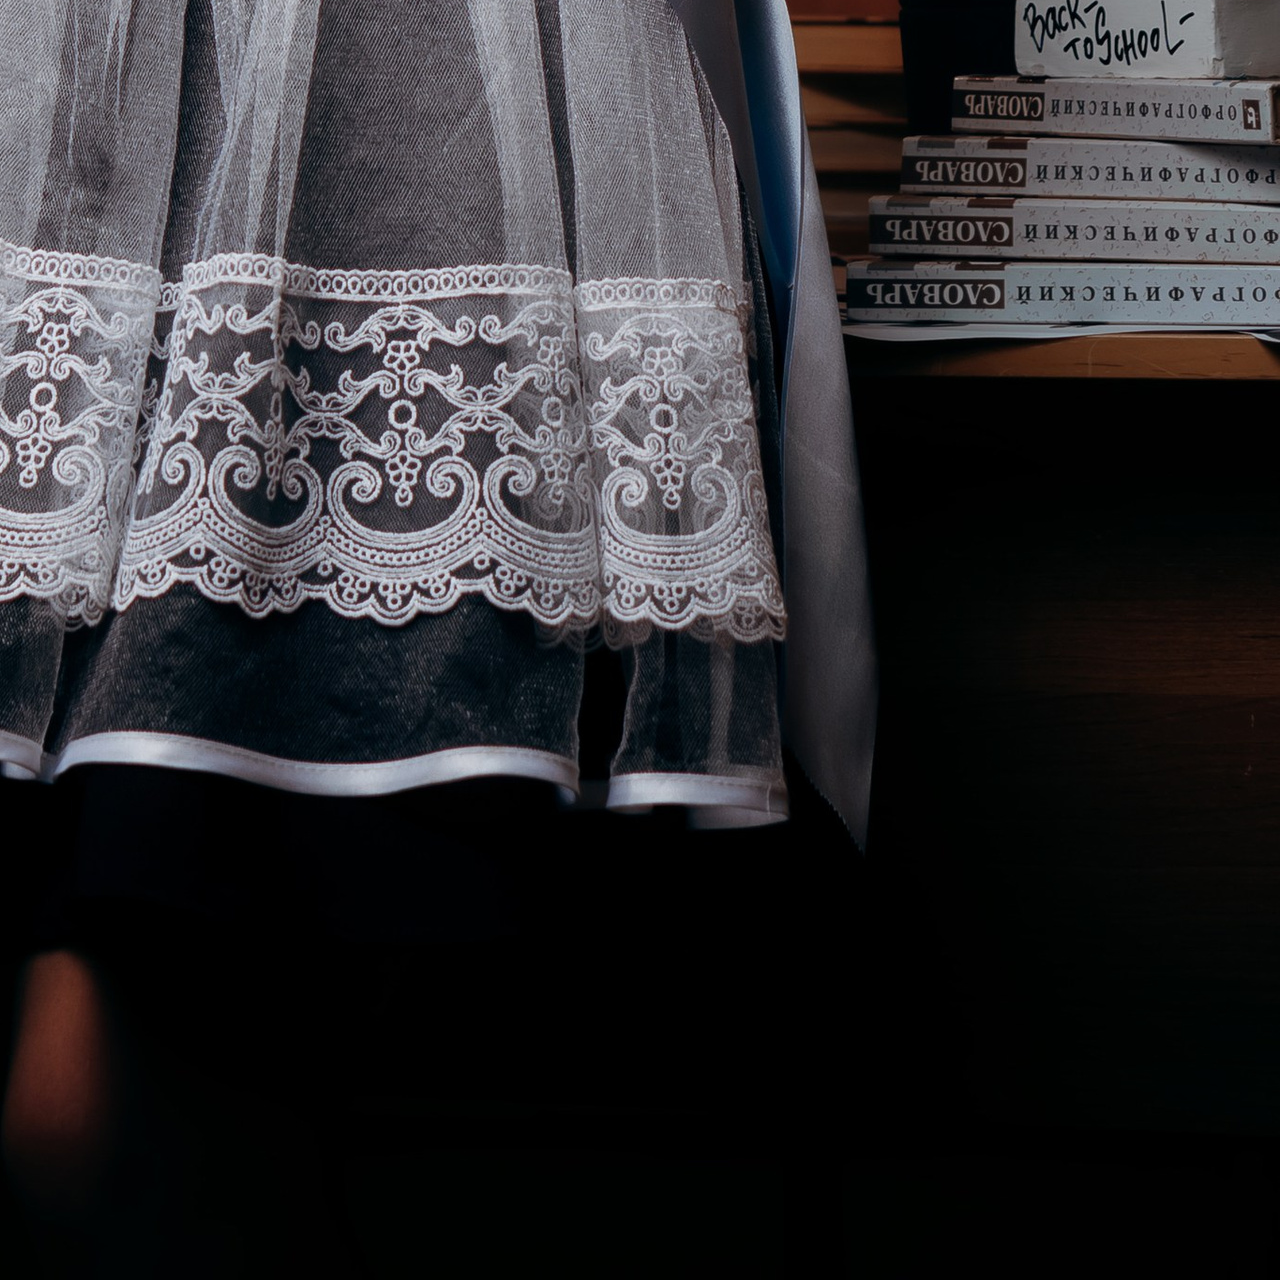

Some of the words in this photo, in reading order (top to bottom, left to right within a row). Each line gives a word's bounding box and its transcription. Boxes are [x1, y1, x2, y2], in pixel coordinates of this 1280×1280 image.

[964, 93, 1044, 120] СЛОВАРЬ
[1050, 97, 1238, 122] ОРФОГРАФИЧЕСКИЙ
[914, 160, 1025, 185] СЛОВАРЬ
[884, 216, 1012, 242] СЛОВАРЬ
[866, 281, 1004, 306] СЛОВАРЬ
